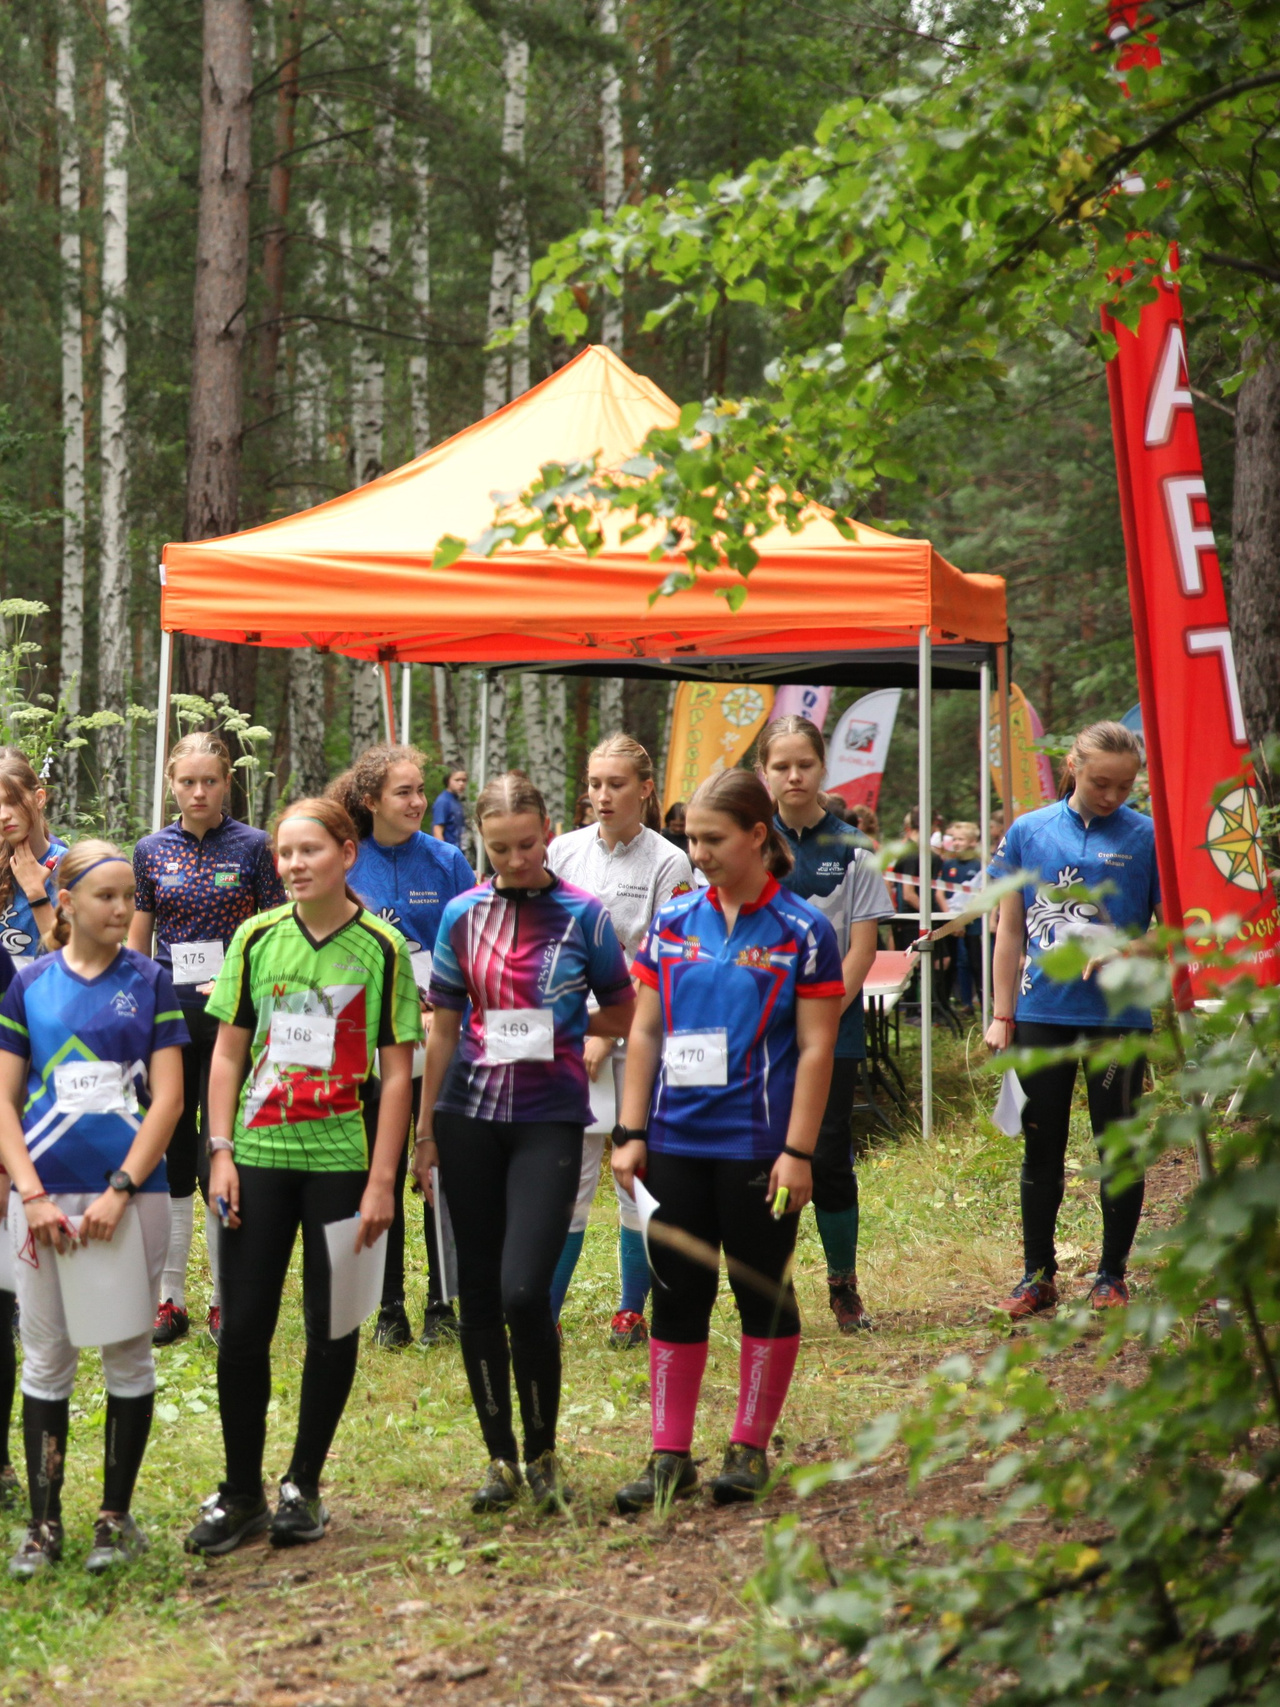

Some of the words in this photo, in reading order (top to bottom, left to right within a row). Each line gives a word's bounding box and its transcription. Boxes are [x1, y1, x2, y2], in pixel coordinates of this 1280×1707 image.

[220, 874, 235, 882] SFR
[618, 883, 649, 891] Сабинина
[182, 952, 205, 965] 175
[272, 983, 287, 998] N
[286, 1026, 312, 1042] 168
[501, 1023, 529, 1037] 169
[679, 1048, 705, 1063] 170
[70, 1075, 98, 1090] 167
[480, 1359, 494, 1401] NORD
[531, 1380, 540, 1416] NORD
[656, 1362, 668, 1432] NORDSKI
[742, 1359, 763, 1427] NORDSKI
